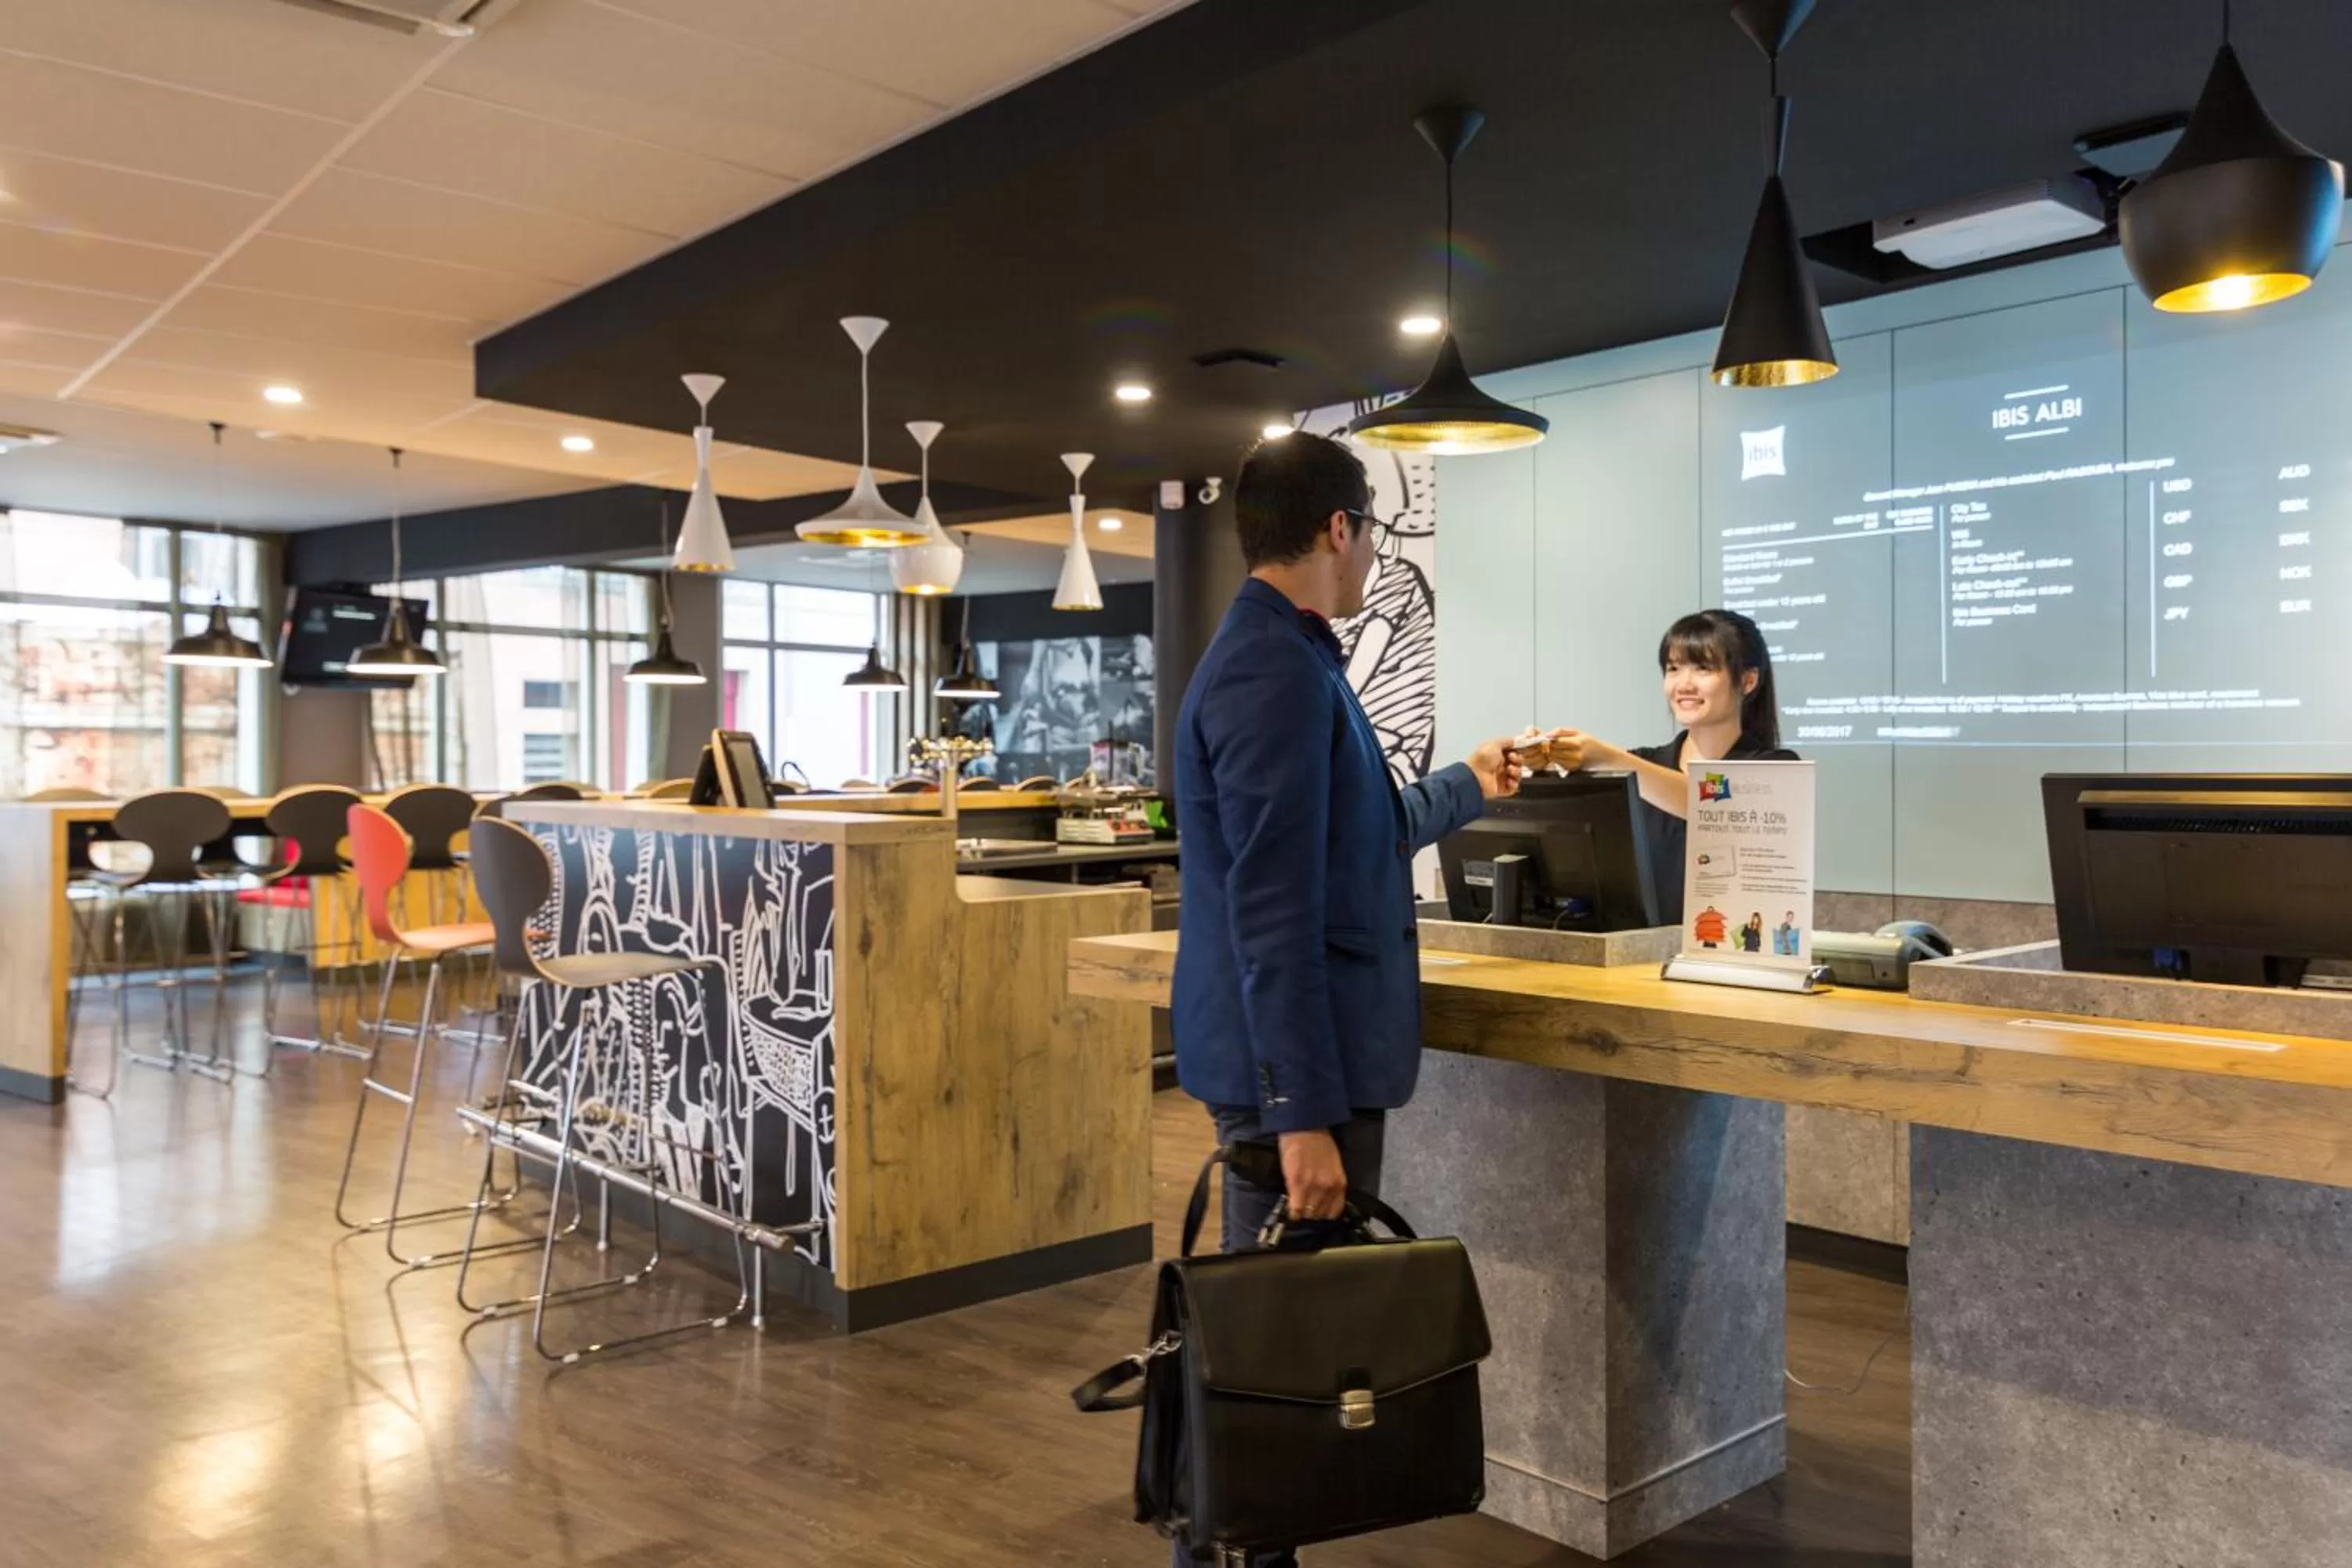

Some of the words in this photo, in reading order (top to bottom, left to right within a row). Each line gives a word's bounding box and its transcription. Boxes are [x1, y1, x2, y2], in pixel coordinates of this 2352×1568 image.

[1992, 405, 2030, 429] IBIS
[2034, 396, 2082, 423] ALBI
[1748, 442, 1777, 462] ibis
[2278, 463, 2311, 480] AUD
[2163, 510, 2192, 524] CHF
[1727, 811, 1747, 823] IBIS
